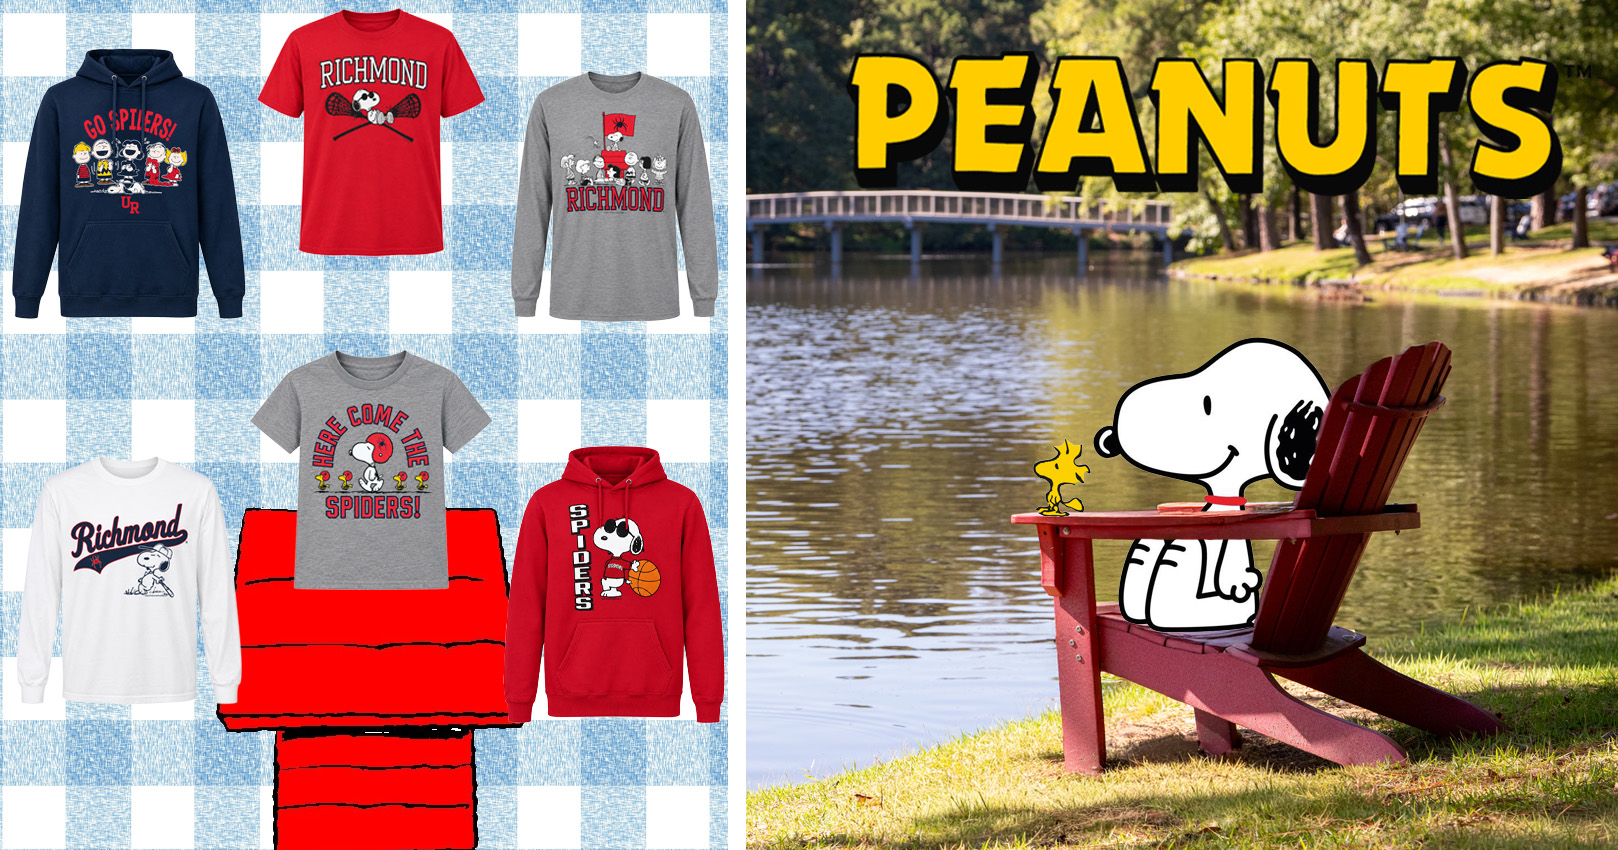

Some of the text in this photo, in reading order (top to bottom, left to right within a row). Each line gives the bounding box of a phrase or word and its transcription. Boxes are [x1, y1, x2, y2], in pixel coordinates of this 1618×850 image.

[319, 55, 428, 90] RICHMOND
[83, 114, 107, 140] GO
[566, 186, 665, 212] RICHMOND
[312, 403, 430, 468] HERE COME THE
[325, 495, 421, 519] SPIDERS!
[70, 503, 184, 559] Richmond
[568, 503, 594, 611] SPIDERS
